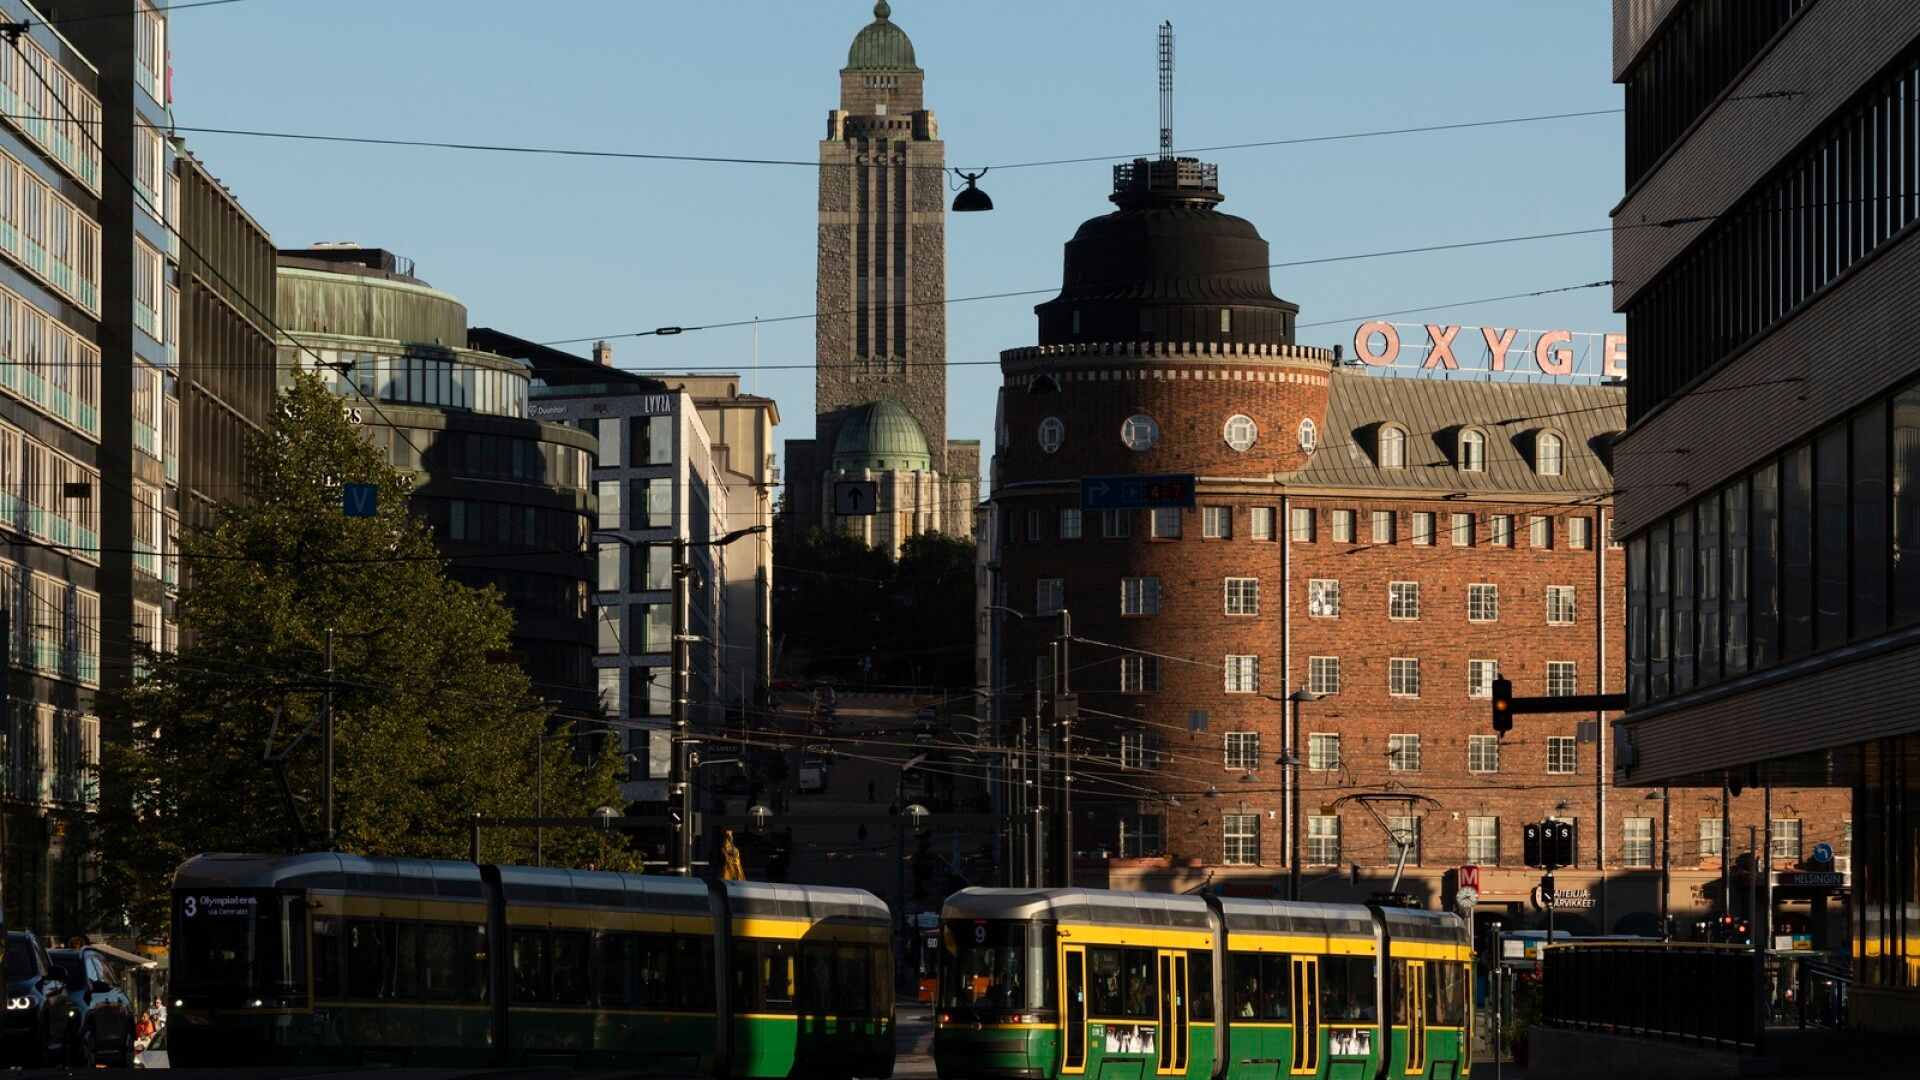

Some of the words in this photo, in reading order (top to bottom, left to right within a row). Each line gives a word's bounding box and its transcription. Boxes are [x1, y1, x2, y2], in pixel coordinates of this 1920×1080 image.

[1354, 321, 1627, 376] OXYGE
[645, 395, 671, 413] LYYRA
[352, 487, 369, 513] V
[1528, 828, 1535, 838] S
[1545, 828, 1552, 838] S
[1561, 828, 1568, 838] S
[1462, 868, 1478, 885] M
[1793, 874, 1841, 884] HELSINGIN
[1554, 889, 1591, 898] AITEILIJA-
[184, 896, 198, 918] 3
[1554, 899, 1596, 908] ARVIKKEET
[974, 925, 986, 944] 9
